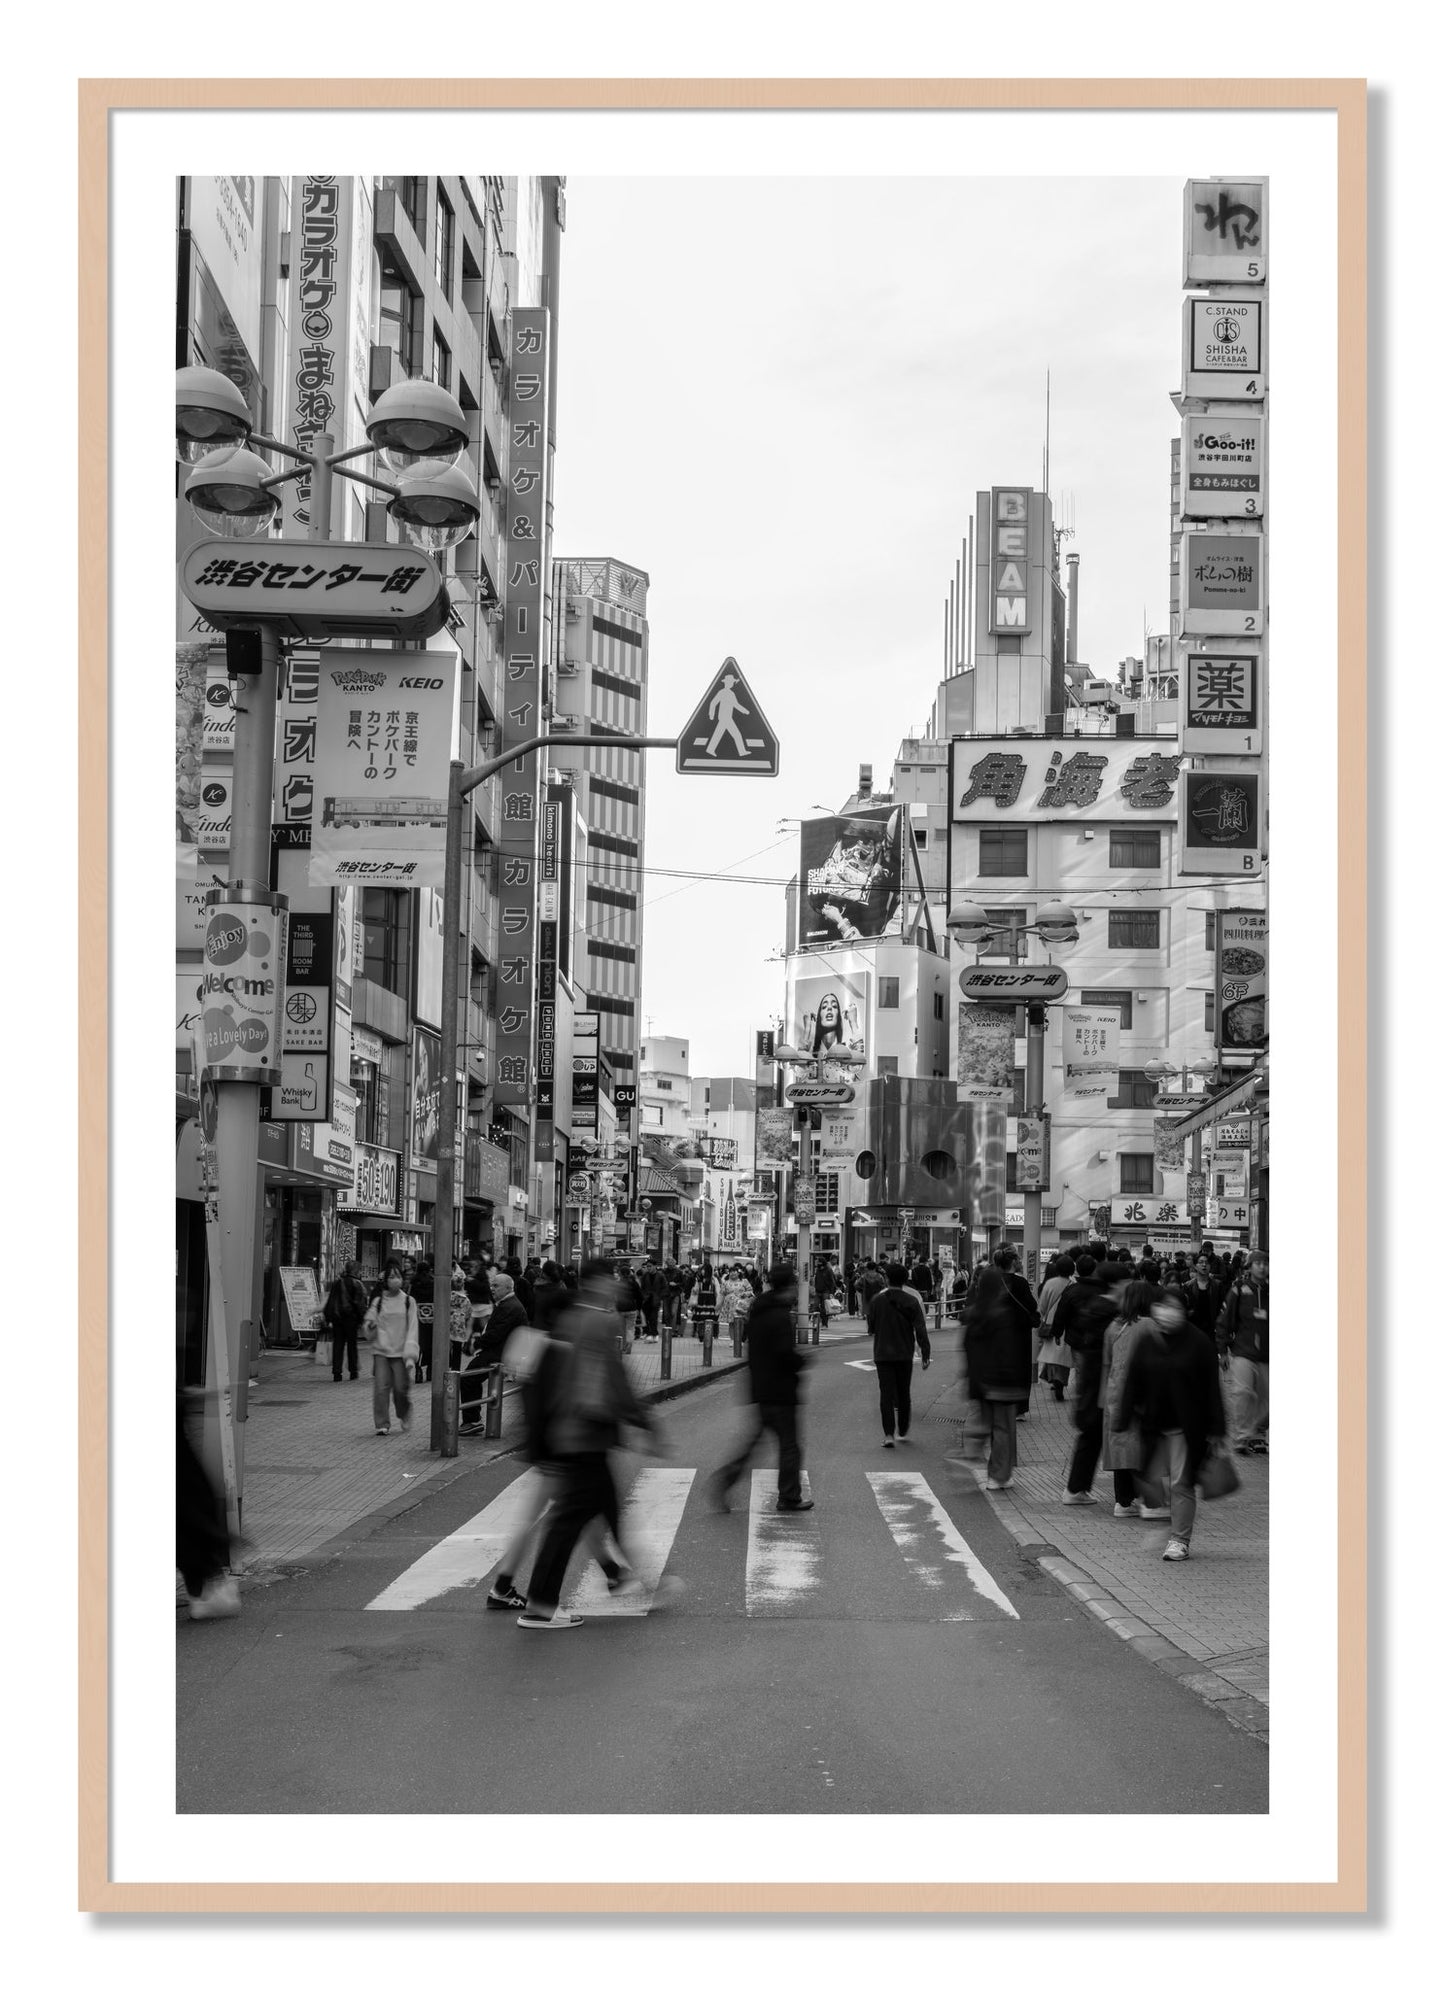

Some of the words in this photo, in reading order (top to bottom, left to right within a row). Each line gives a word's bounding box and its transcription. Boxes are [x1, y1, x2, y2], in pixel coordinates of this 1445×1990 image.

[299, 183, 339, 312] カラオケ
[1247, 262, 1259, 277] 5
[1205, 306, 1248, 316] C.STAND
[1206, 344, 1247, 354] SHISHA
[1206, 355, 1248, 363] CAFE&BAR
[1204, 435, 1256, 451] Goo-it!
[1193, 477, 1256, 488] 全身もみほぐし
[1245, 498, 1256, 514] 3
[996, 492, 1026, 627] BEAM
[194, 558, 428, 595] 渋谷センター街
[1244, 616, 1256, 632] 2
[342, 684, 375, 692] KANTO
[398, 676, 444, 690] KEIO
[1197, 661, 1245, 709] 薬
[347, 710, 362, 750] 冒険へ
[207, 736, 230, 745] 渋谷店
[364, 710, 381, 780] カントーの
[403, 711, 419, 767] 京王線で
[1244, 735, 1252, 751] 1
[959, 750, 1182, 809] 角海老
[546, 806, 555, 840] kimono
[335, 861, 418, 874] 渋谷センター街
[1243, 855, 1254, 870] B
[207, 925, 244, 960] Enjoy
[293, 931, 314, 939] THIRD
[295, 967, 310, 975] BAR
[499, 859, 531, 1087] カラオケ館
[202, 972, 275, 997] Welcome
[965, 973, 1063, 987] 渋谷センター街
[1222, 982, 1249, 1001] 6F
[218, 1026, 247, 1046] Lovely
[248, 1027, 267, 1041] Day!
[280, 1097, 301, 1105] Bank
[281, 1087, 313, 1099] Whisky
[616, 1091, 635, 1101] GU
[1123, 1201, 1179, 1222] 兆楽
